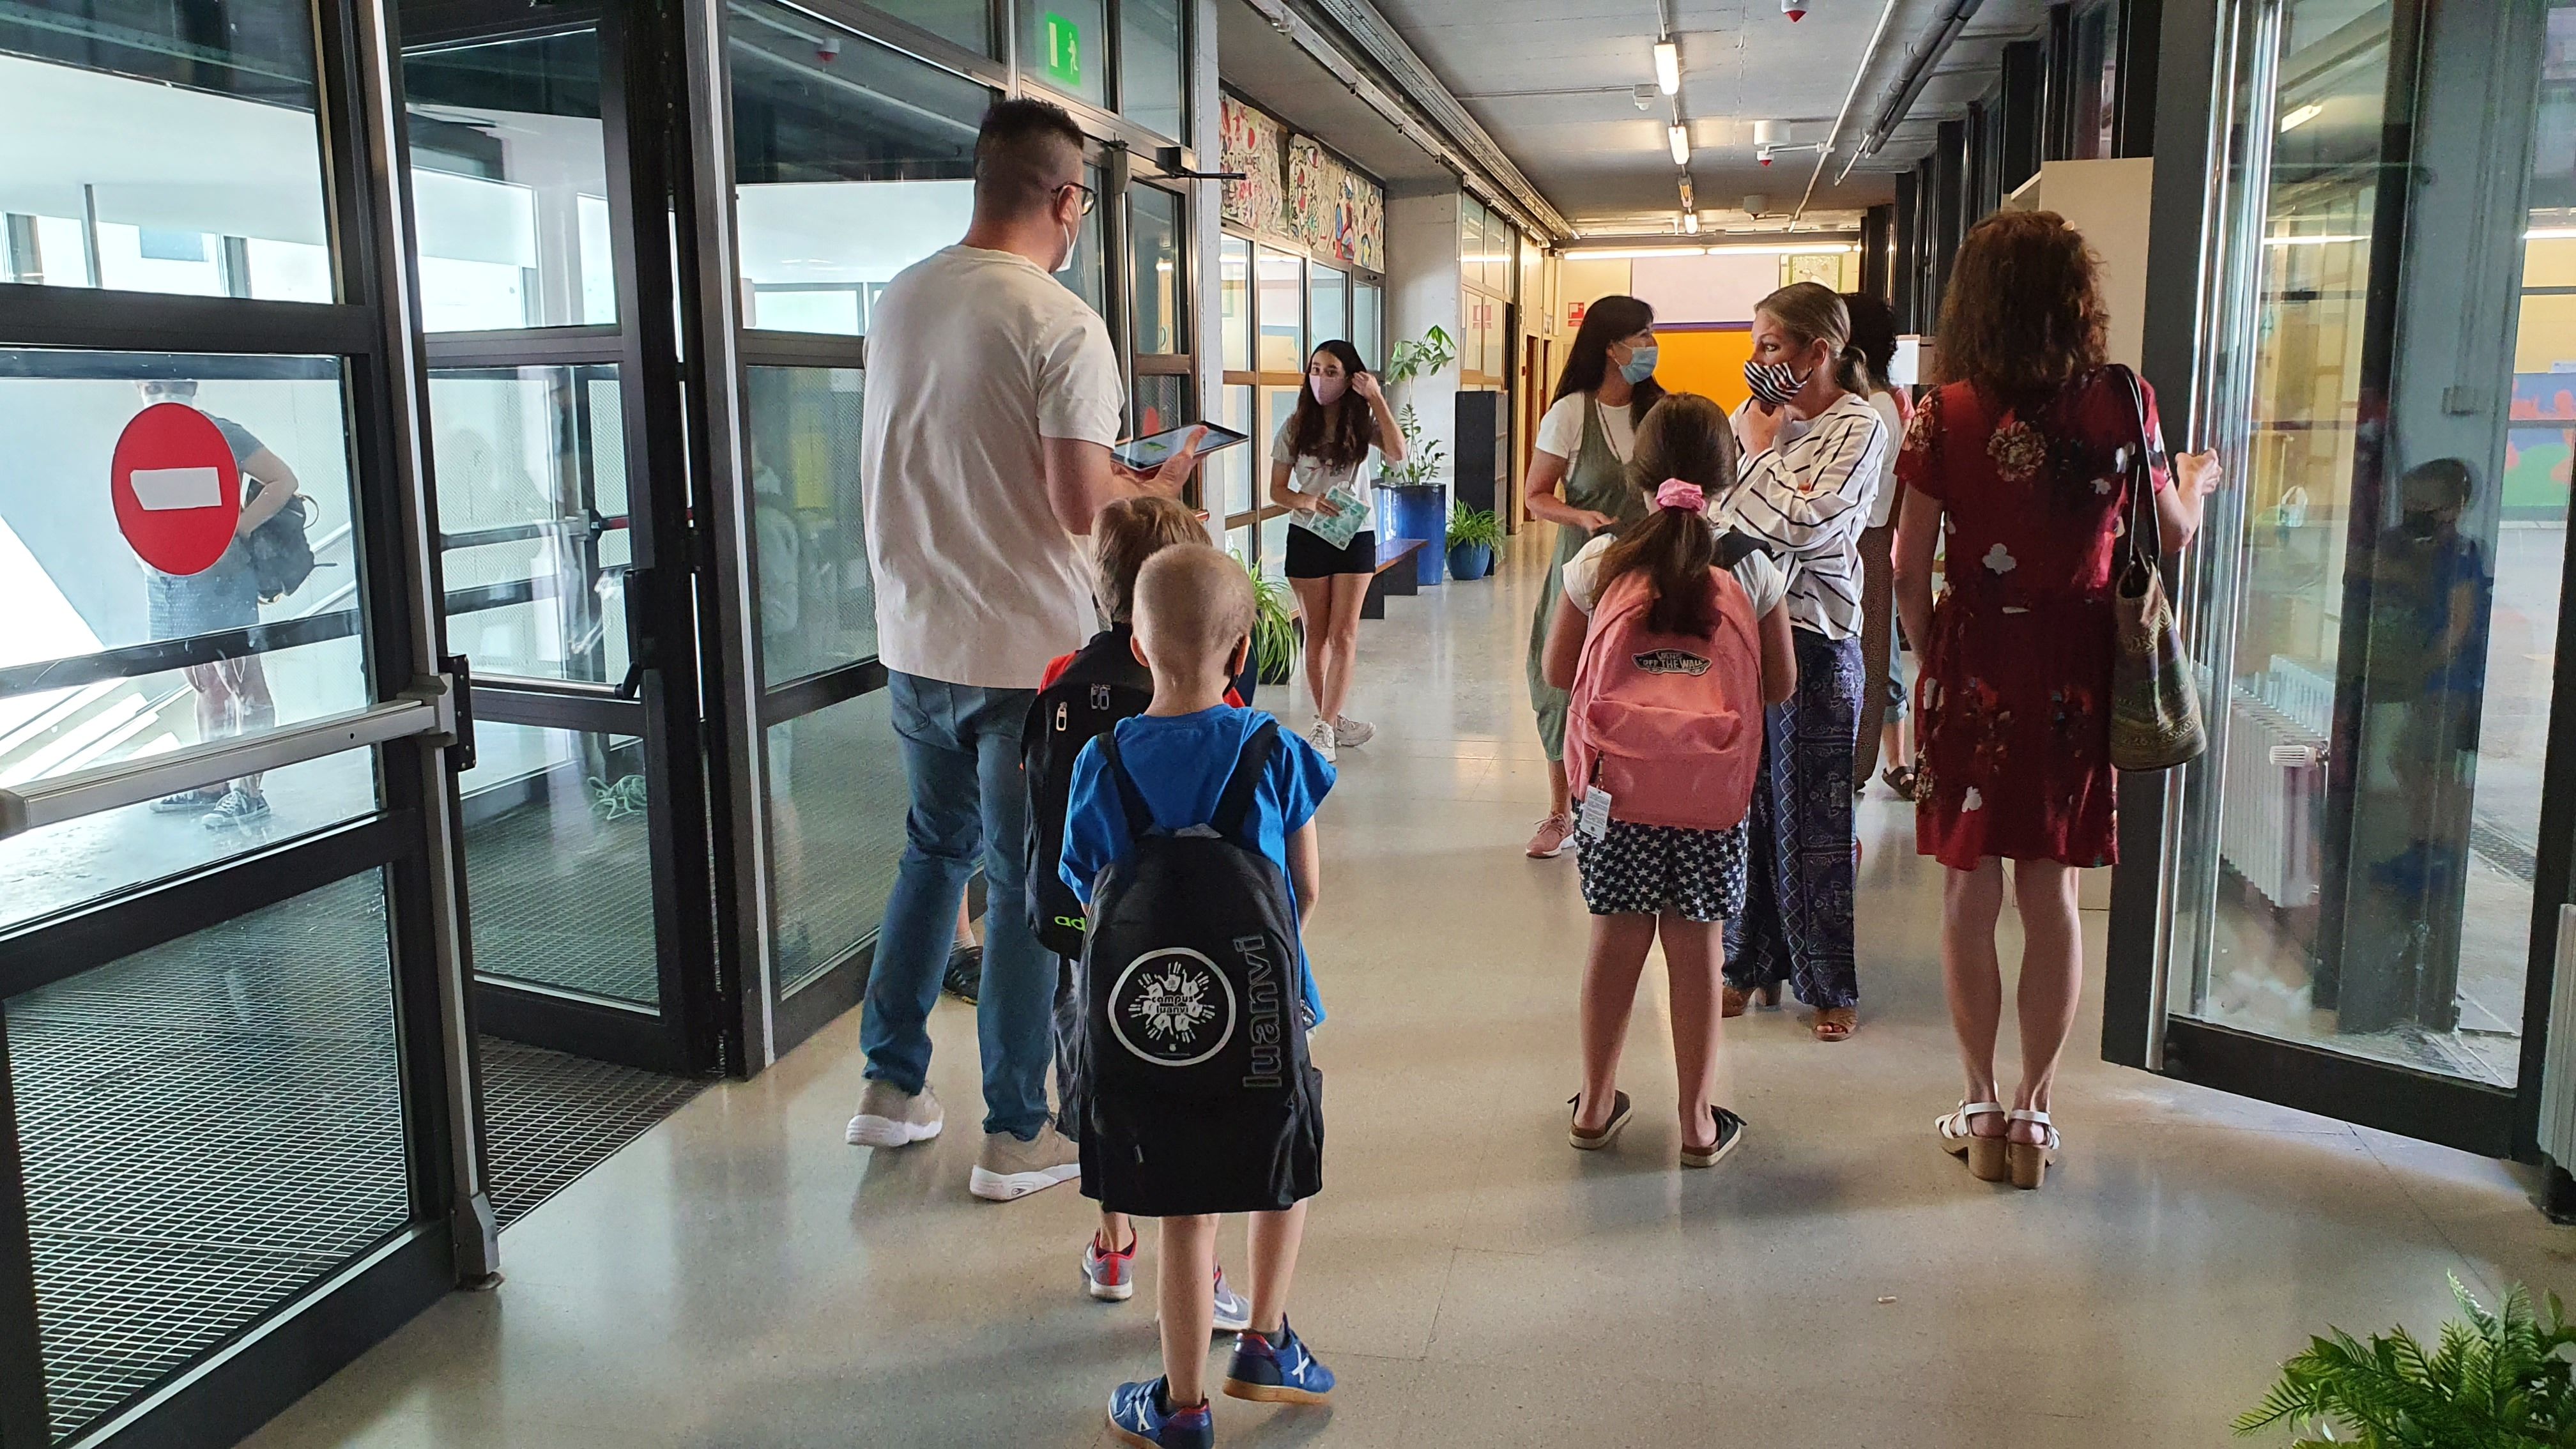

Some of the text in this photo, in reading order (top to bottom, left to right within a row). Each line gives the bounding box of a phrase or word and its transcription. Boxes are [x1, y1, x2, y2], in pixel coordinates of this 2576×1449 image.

[1151, 995, 1193, 1004] campus
[1156, 1006, 1188, 1014] luanvi
[1232, 935, 1282, 1087] luanvi
